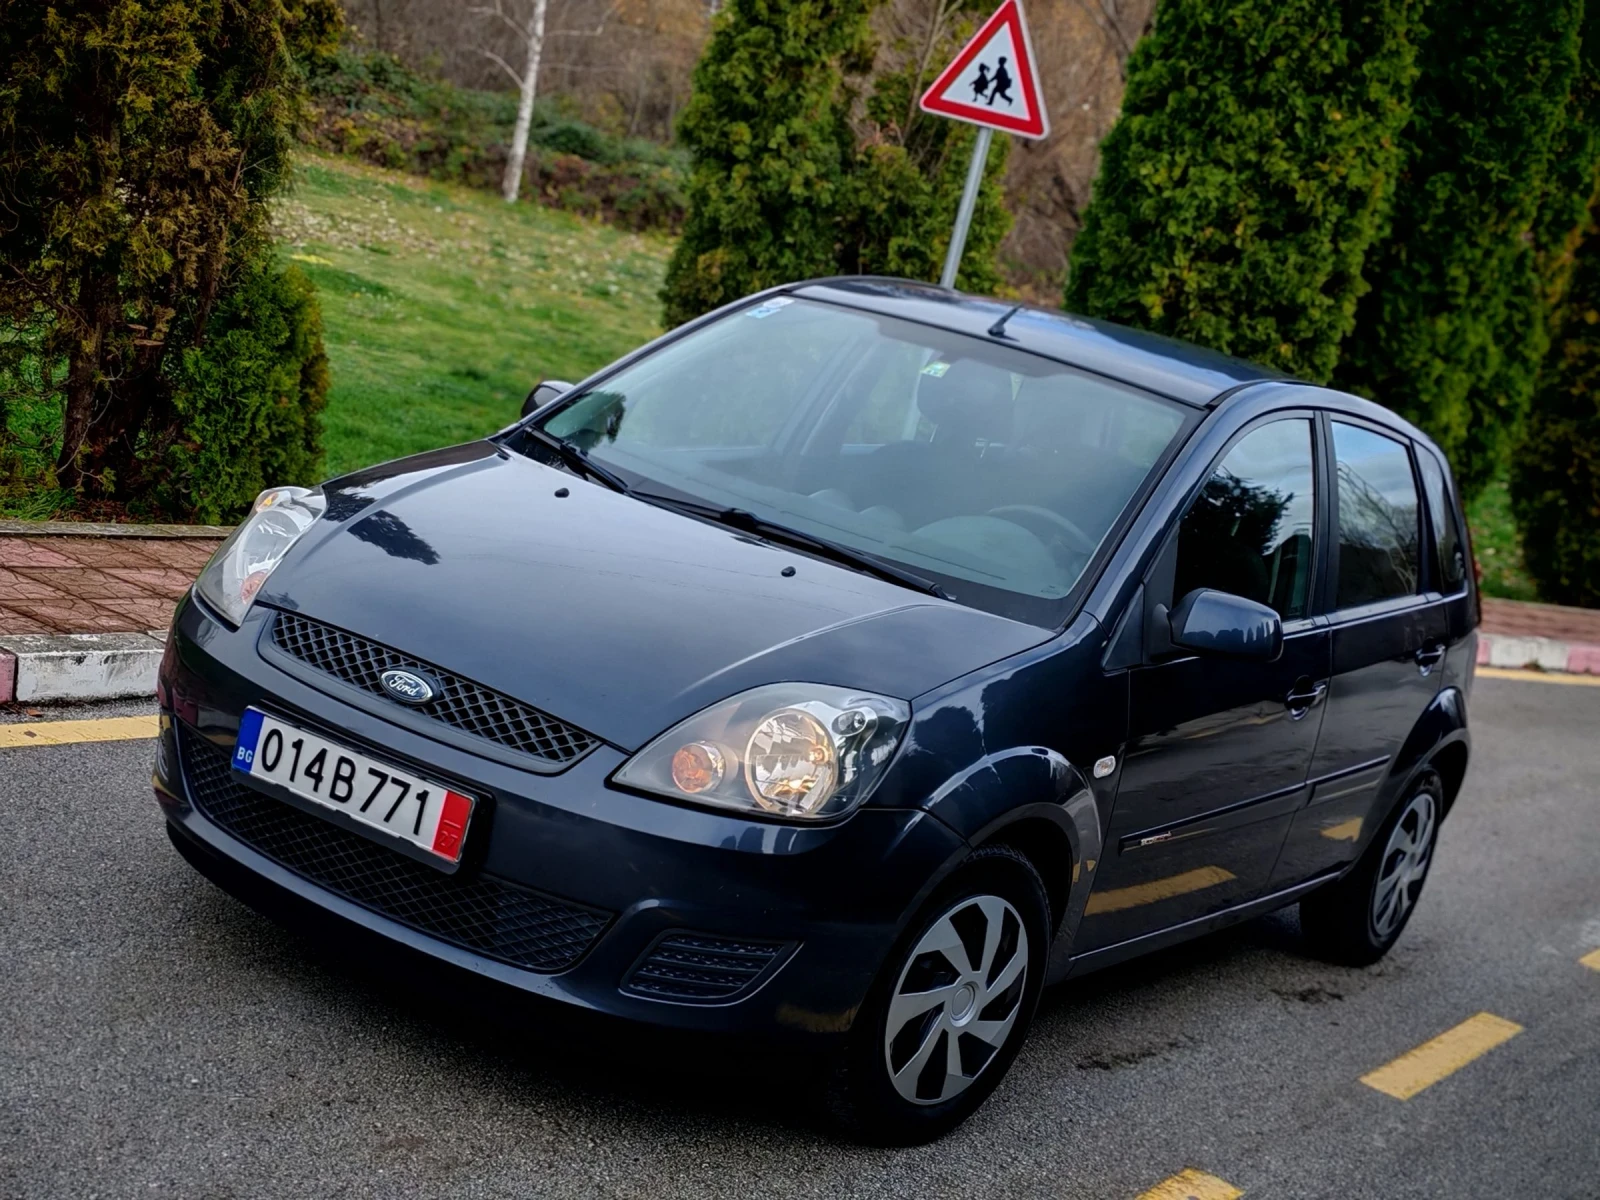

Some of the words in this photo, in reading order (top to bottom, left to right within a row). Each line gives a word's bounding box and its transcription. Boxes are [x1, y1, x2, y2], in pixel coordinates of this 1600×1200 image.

[389, 675, 420, 696] Ford
[236, 746, 253, 763] BG
[261, 728, 430, 836] 014B771
